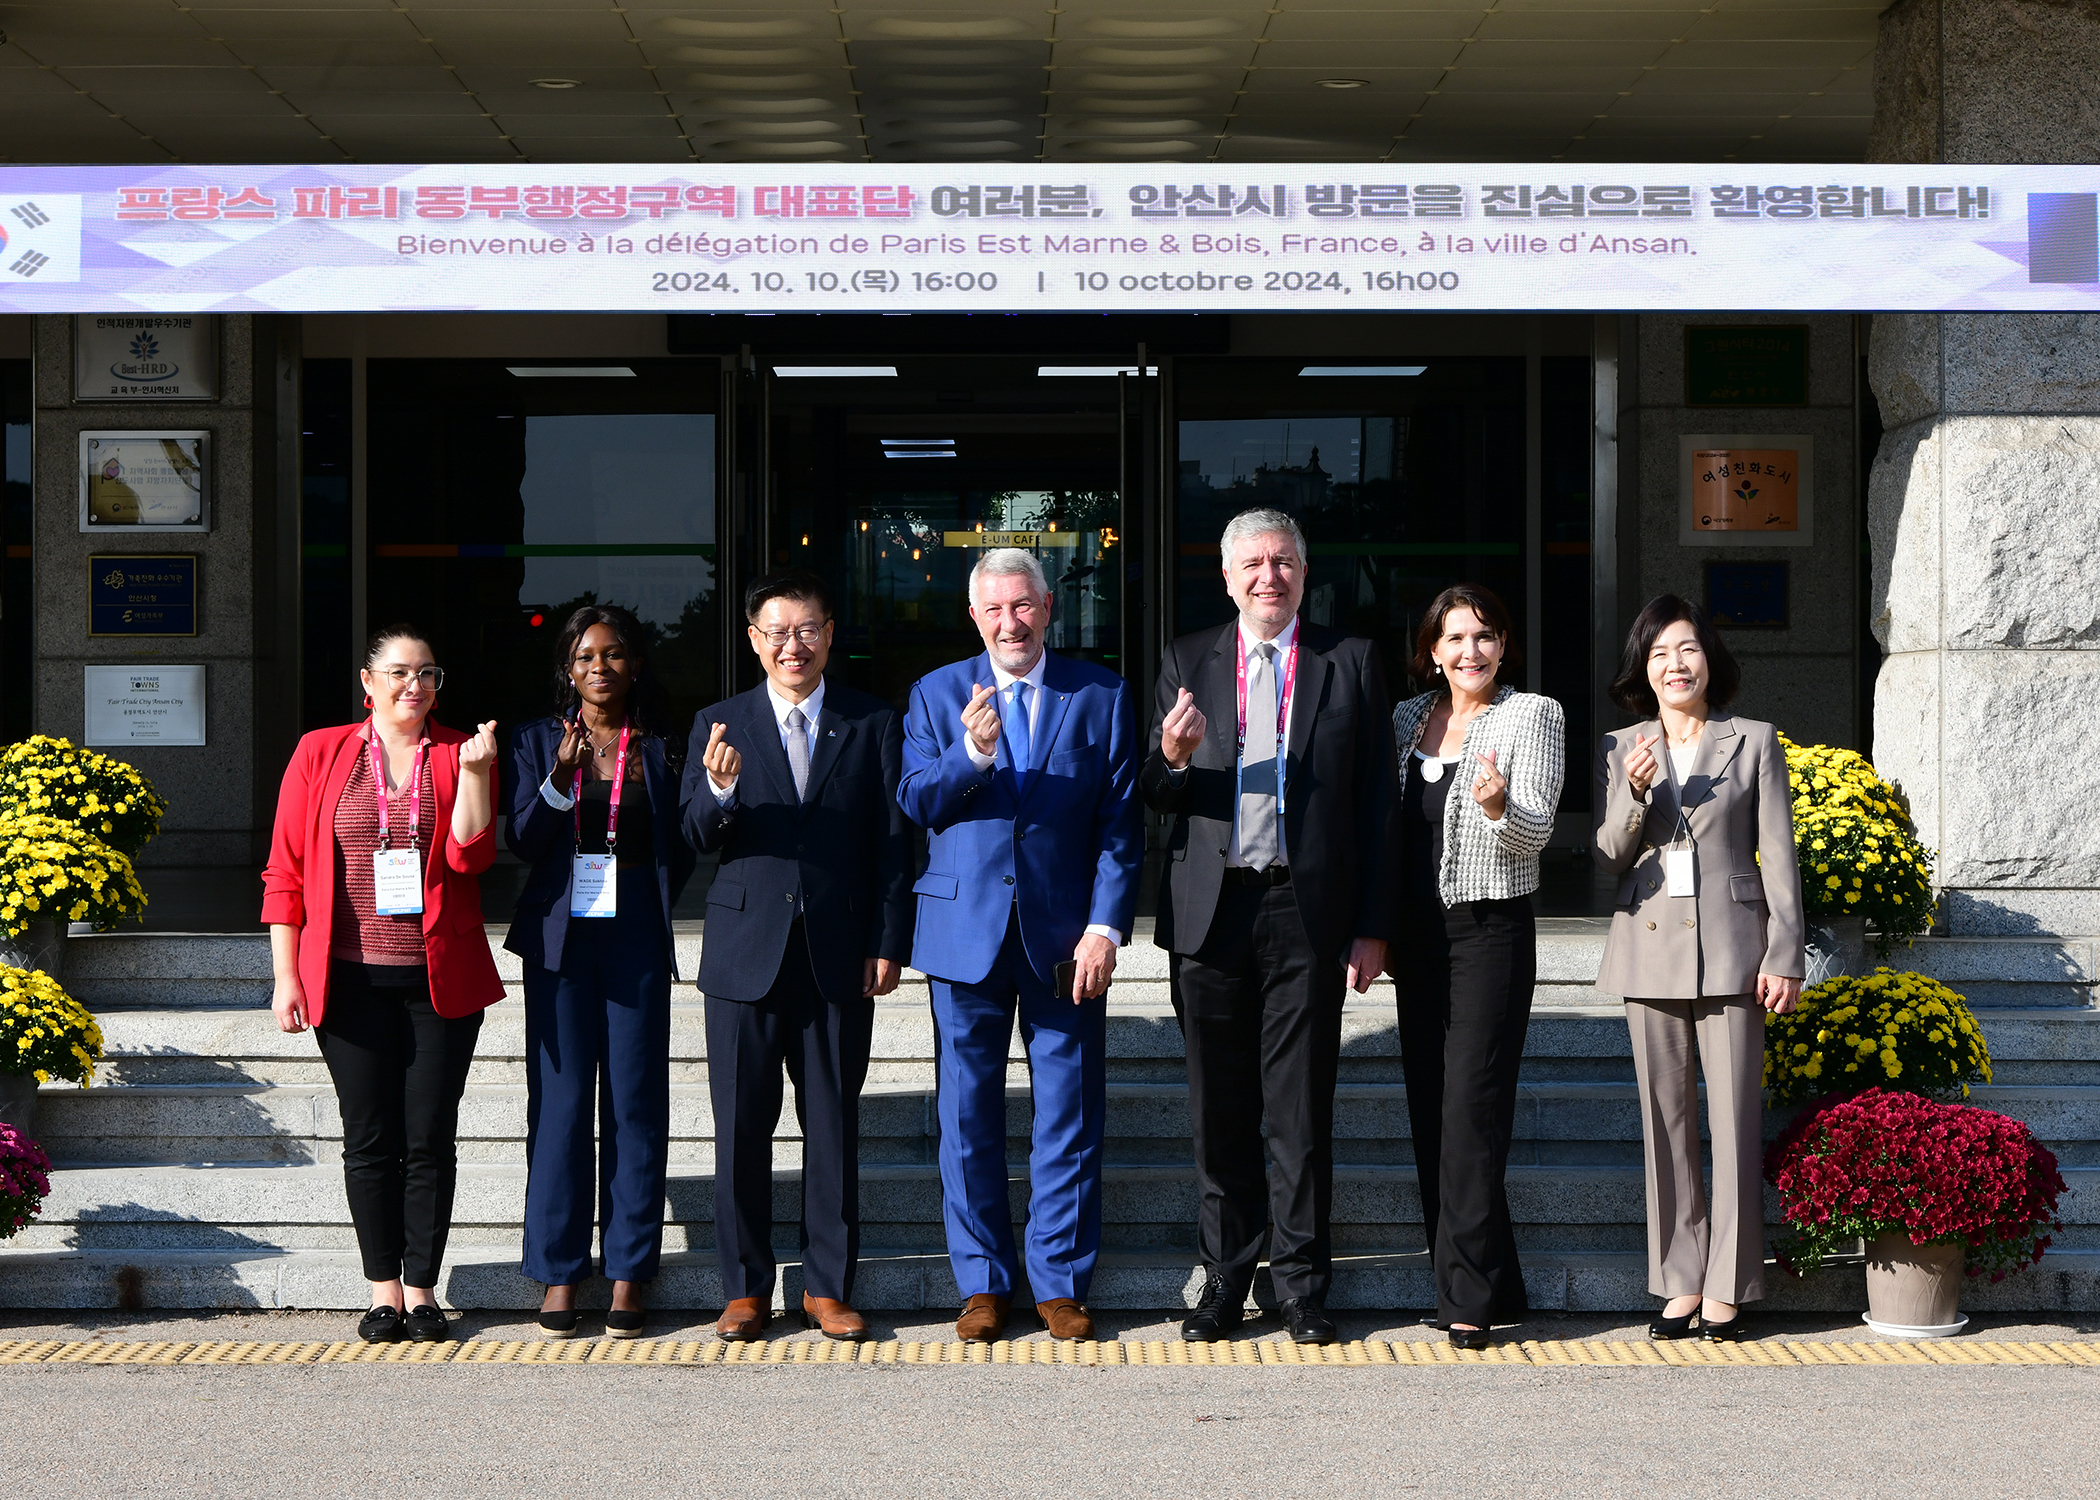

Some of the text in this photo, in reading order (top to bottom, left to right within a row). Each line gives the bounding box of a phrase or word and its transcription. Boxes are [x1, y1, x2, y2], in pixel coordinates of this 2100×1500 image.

[116, 184, 1989, 219] 프랑스 파리 동부행정구역 대표단 여러분, 안산시 방문을 진심으로 환영합니다!
[398, 234, 567, 254] Bienvenue
[577, 232, 594, 254] à
[607, 234, 634, 254] la
[645, 231, 819, 257] délégation
[829, 233, 869, 254] de
[881, 233, 966, 254] Paris
[978, 234, 1032, 254] Est
[1044, 234, 1148, 254] Marne
[1159, 233, 1180, 253] &
[1192, 233, 1270, 257] Bois,
[1283, 233, 1407, 257] France,
[1418, 231, 1435, 252] à
[1447, 234, 1474, 253] la
[1484, 233, 1547, 253] ville
[652, 272, 739, 293] 2024.
[751, 272, 793, 293] 10.
[911, 271, 998, 292] 16:00
[1075, 271, 1109, 292] 10
[1119, 271, 1253, 292] octobre
[1264, 271, 1351, 295] 2024,
[1362, 270, 1459, 291] 16h00
[96, 318, 192, 328] 인적자원개발우수기관
[1756, 338, 1790, 352] 2014
[121, 363, 168, 375] Best-HRD
[1702, 462, 1792, 484] 여성친화도시
[982, 535, 1010, 544] E-UM
